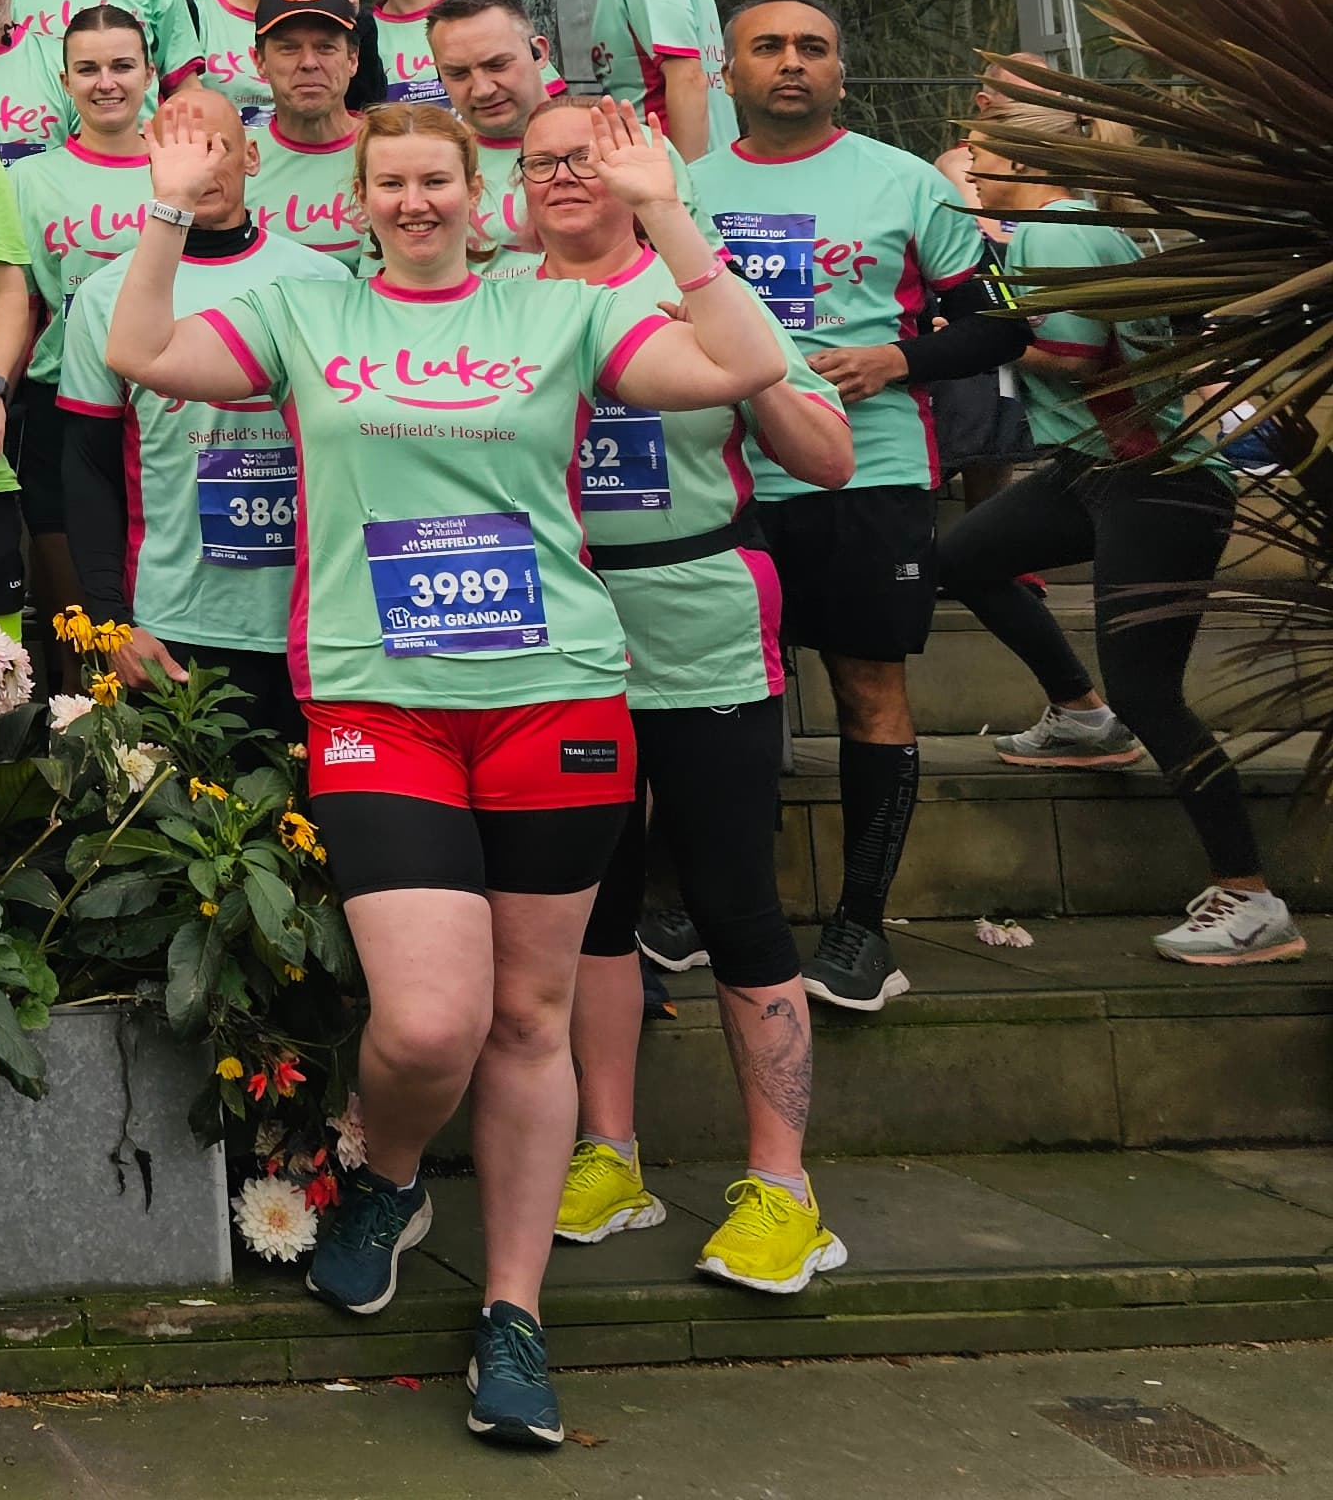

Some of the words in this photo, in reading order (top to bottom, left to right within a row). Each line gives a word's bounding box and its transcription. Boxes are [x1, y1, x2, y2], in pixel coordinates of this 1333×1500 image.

[43, 215, 84, 260] St
[722, 228, 769, 238] SHEFFIELD
[815, 313, 846, 326] pice
[324, 355, 388, 404] St
[395, 345, 542, 394] Luke's
[605, 406, 626, 416] 10K
[188, 428, 258, 445] Sheffield's
[359, 422, 446, 439] Sheffield's
[450, 425, 516, 442] Hospice
[578, 437, 621, 469] 32
[242, 467, 287, 477] SHEFFIELD
[432, 518, 467, 530] Sheffield
[265, 533, 283, 544] PB
[434, 527, 464, 537] Mutual
[420, 536, 477, 550] SHEFFIELD
[477, 534, 500, 546] 10K
[409, 568, 509, 608] 3989
[410, 614, 441, 629] FOR
[444, 609, 522, 625] GRANDAD
[324, 748, 376, 762] RHINO
[563, 747, 585, 757] TEAM
